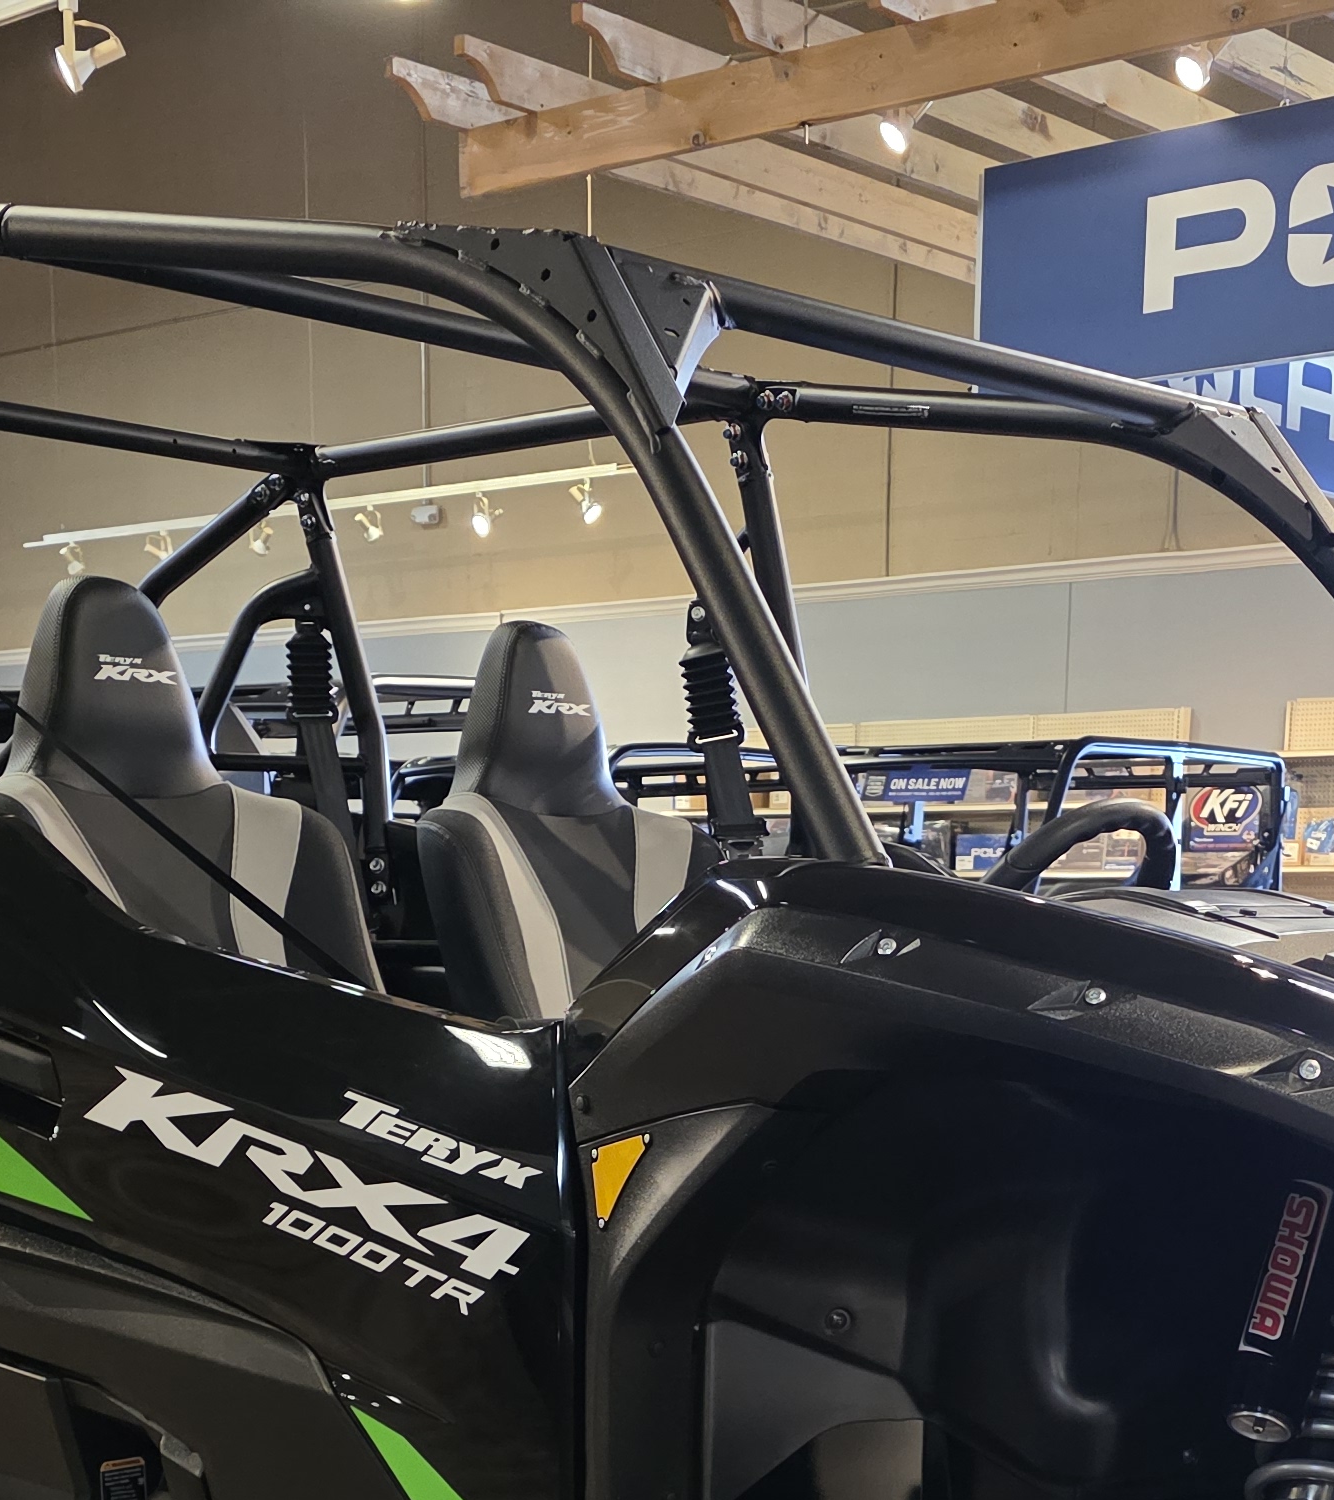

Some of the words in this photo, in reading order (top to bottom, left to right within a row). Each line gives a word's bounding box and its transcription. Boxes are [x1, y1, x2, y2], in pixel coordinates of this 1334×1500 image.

[93, 664, 178, 686] KRX
[527, 699, 591, 717] KRX
[890, 778, 907, 790] ON
[907, 778, 938, 790] SALE
[938, 776, 966, 789] NOW
[82, 1064, 531, 1281] KRX4
[1248, 1192, 1319, 1341] SHOWA
